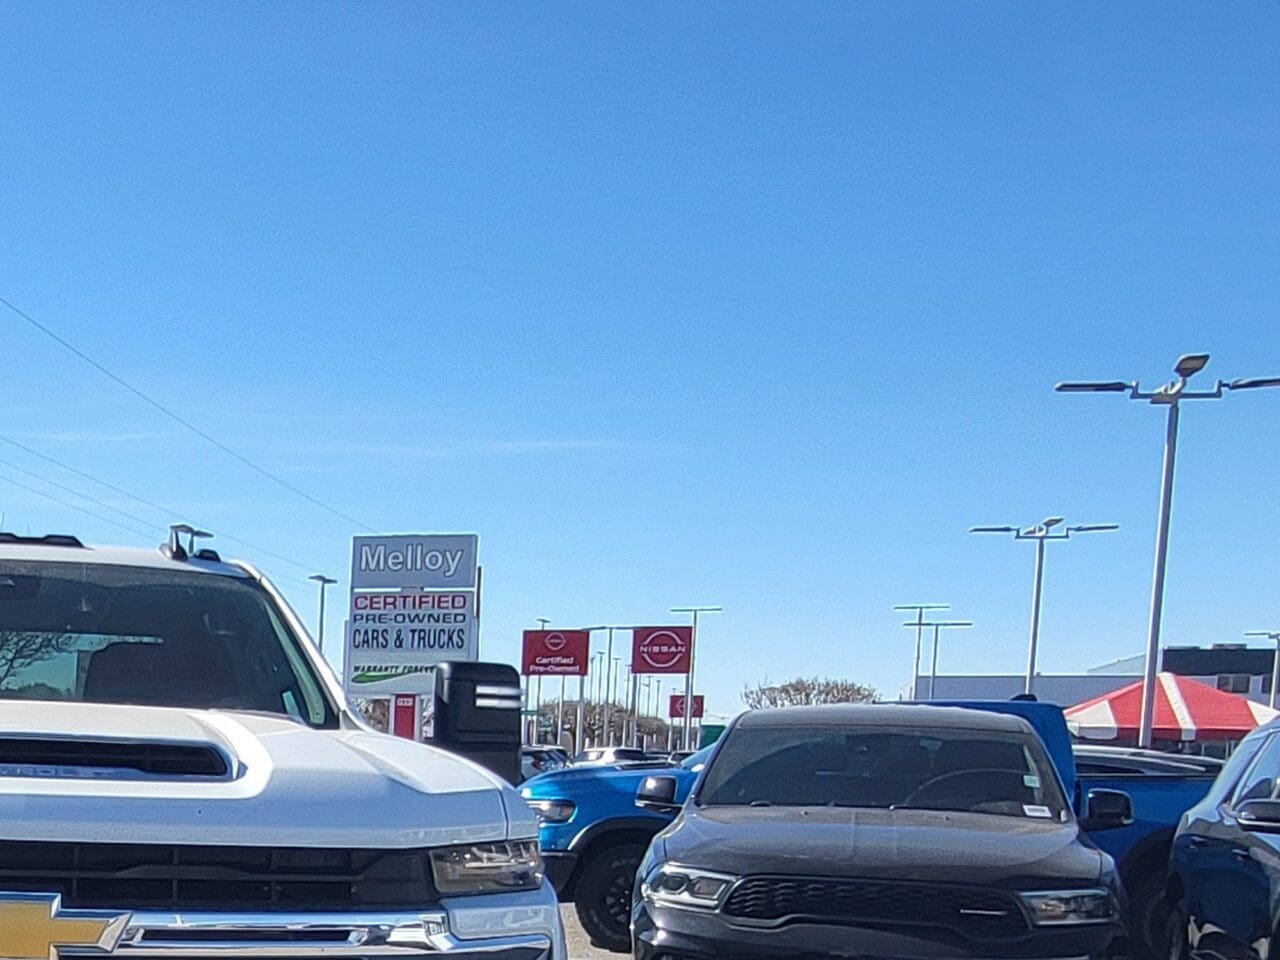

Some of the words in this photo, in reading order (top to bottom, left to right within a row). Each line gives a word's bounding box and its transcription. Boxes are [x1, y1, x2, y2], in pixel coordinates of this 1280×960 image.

[360, 543, 464, 577] Melloy
[354, 594, 466, 611] CERTIFIED
[353, 613, 466, 624] PRE-OWNED
[353, 628, 388, 649] CARS
[394, 629, 404, 649] &
[409, 629, 465, 649] TRUCKS
[639, 644, 686, 653] NISSAN
[535, 656, 575, 664] Certified
[353, 665, 400, 673] WARRANTY
[402, 665, 434, 673] FOREVE
[529, 664, 580, 673] Pre-Owned
